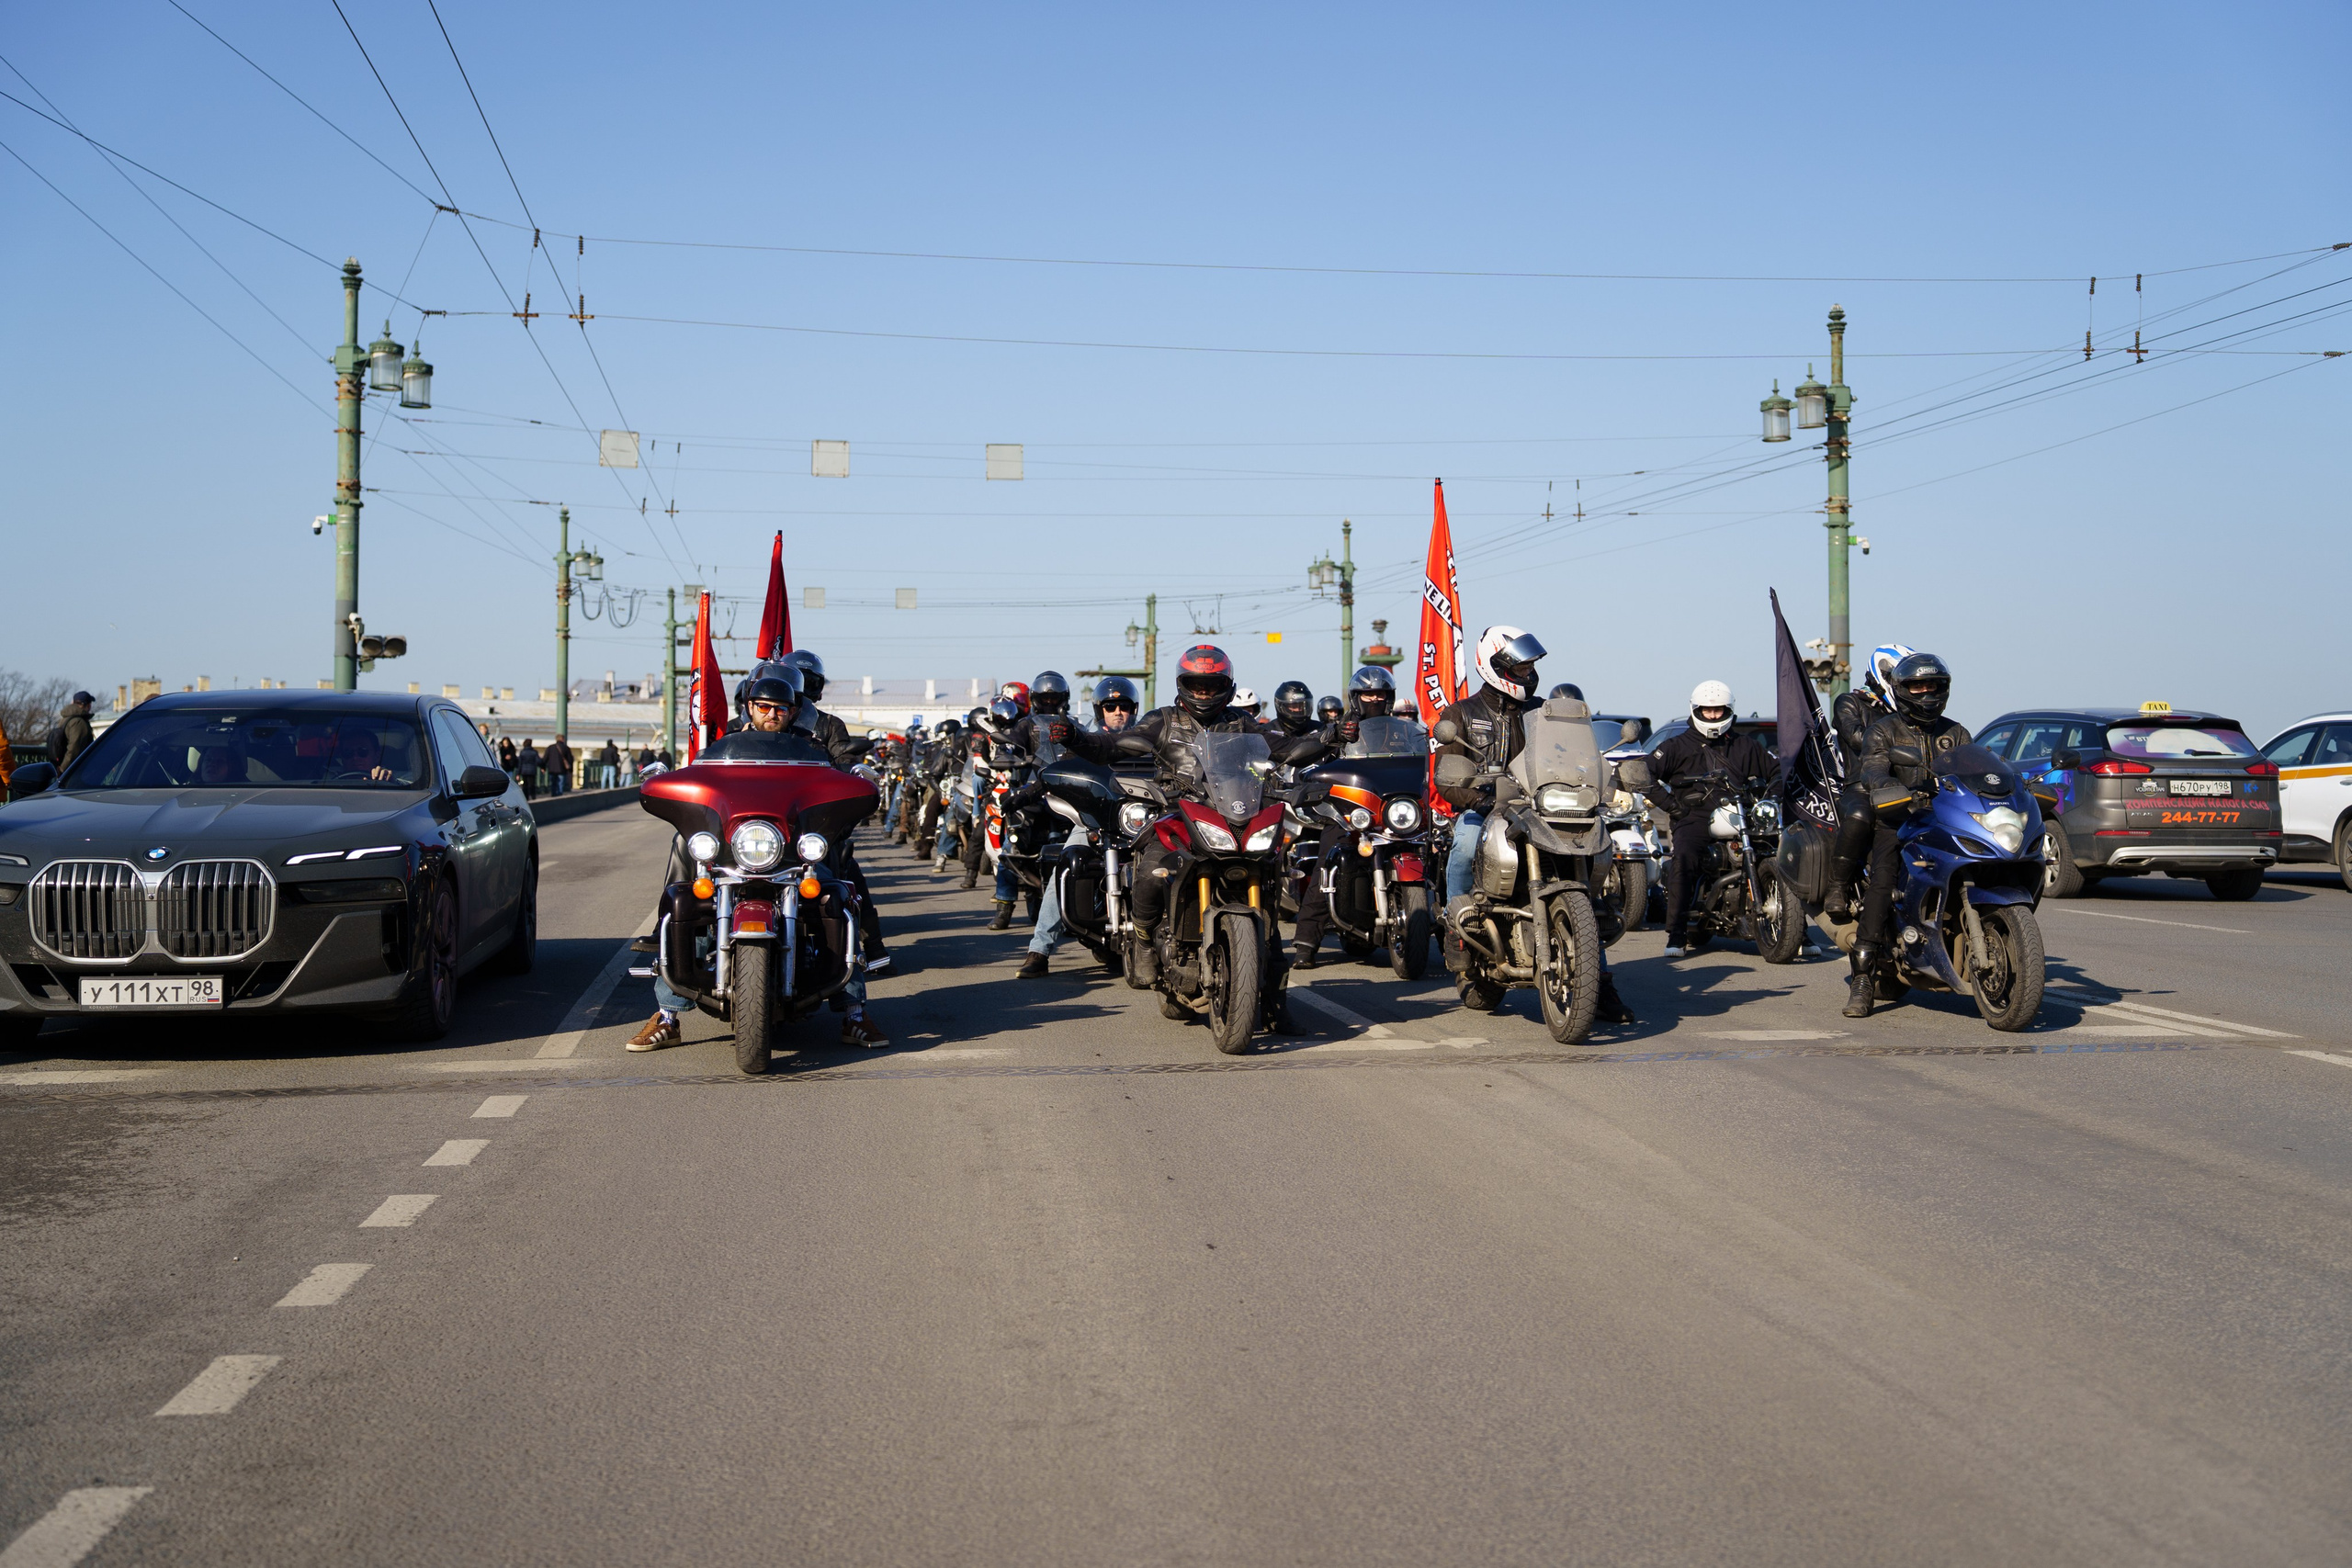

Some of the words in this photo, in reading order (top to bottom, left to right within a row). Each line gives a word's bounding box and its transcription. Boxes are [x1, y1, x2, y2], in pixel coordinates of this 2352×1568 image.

[1422, 642, 1437, 672] ST.
[1424, 673, 1451, 714] PET
[2146, 703, 2167, 711] TAXI
[2214, 782, 2229, 790] 198
[2208, 798, 2249, 809] НАЛОГА
[2249, 801, 2270, 811] СМЗ
[2161, 811, 2241, 823] 244-77-77
[190, 980, 214, 996] 98
